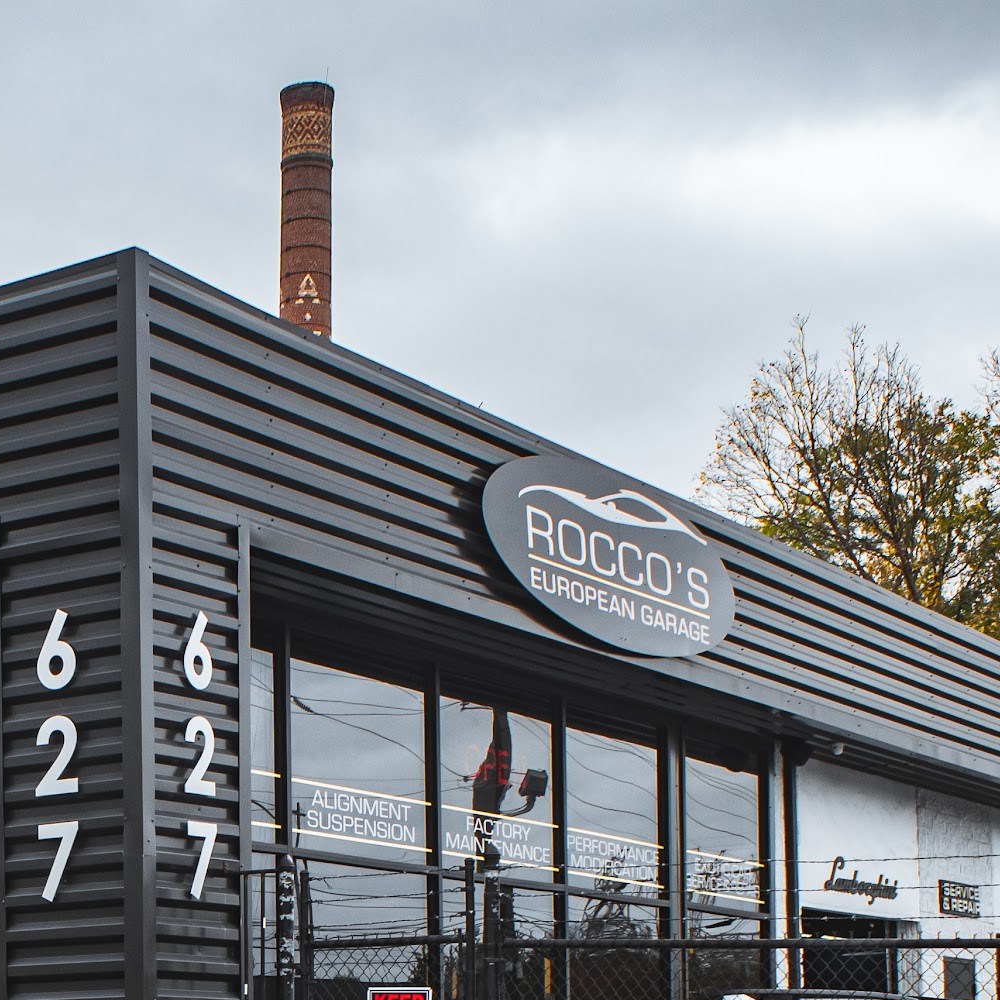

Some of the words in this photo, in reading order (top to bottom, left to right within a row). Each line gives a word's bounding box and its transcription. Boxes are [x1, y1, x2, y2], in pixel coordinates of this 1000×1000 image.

[526, 504, 711, 610] ROCCO'S
[530, 566, 635, 621] EUROPEAN
[640, 604, 710, 646] GARAGE
[311, 789, 412, 822] ALIGNMENT
[306, 810, 416, 843] SUSPENSION
[465, 815, 531, 841] FACTORY
[567, 834, 660, 865] PERFORMANCE
[570, 853, 658, 882] MODIFICATION
[942, 897, 950, 910] &
[951, 898, 980, 915] REPAIR
[943, 882, 979, 901] SERVICE
